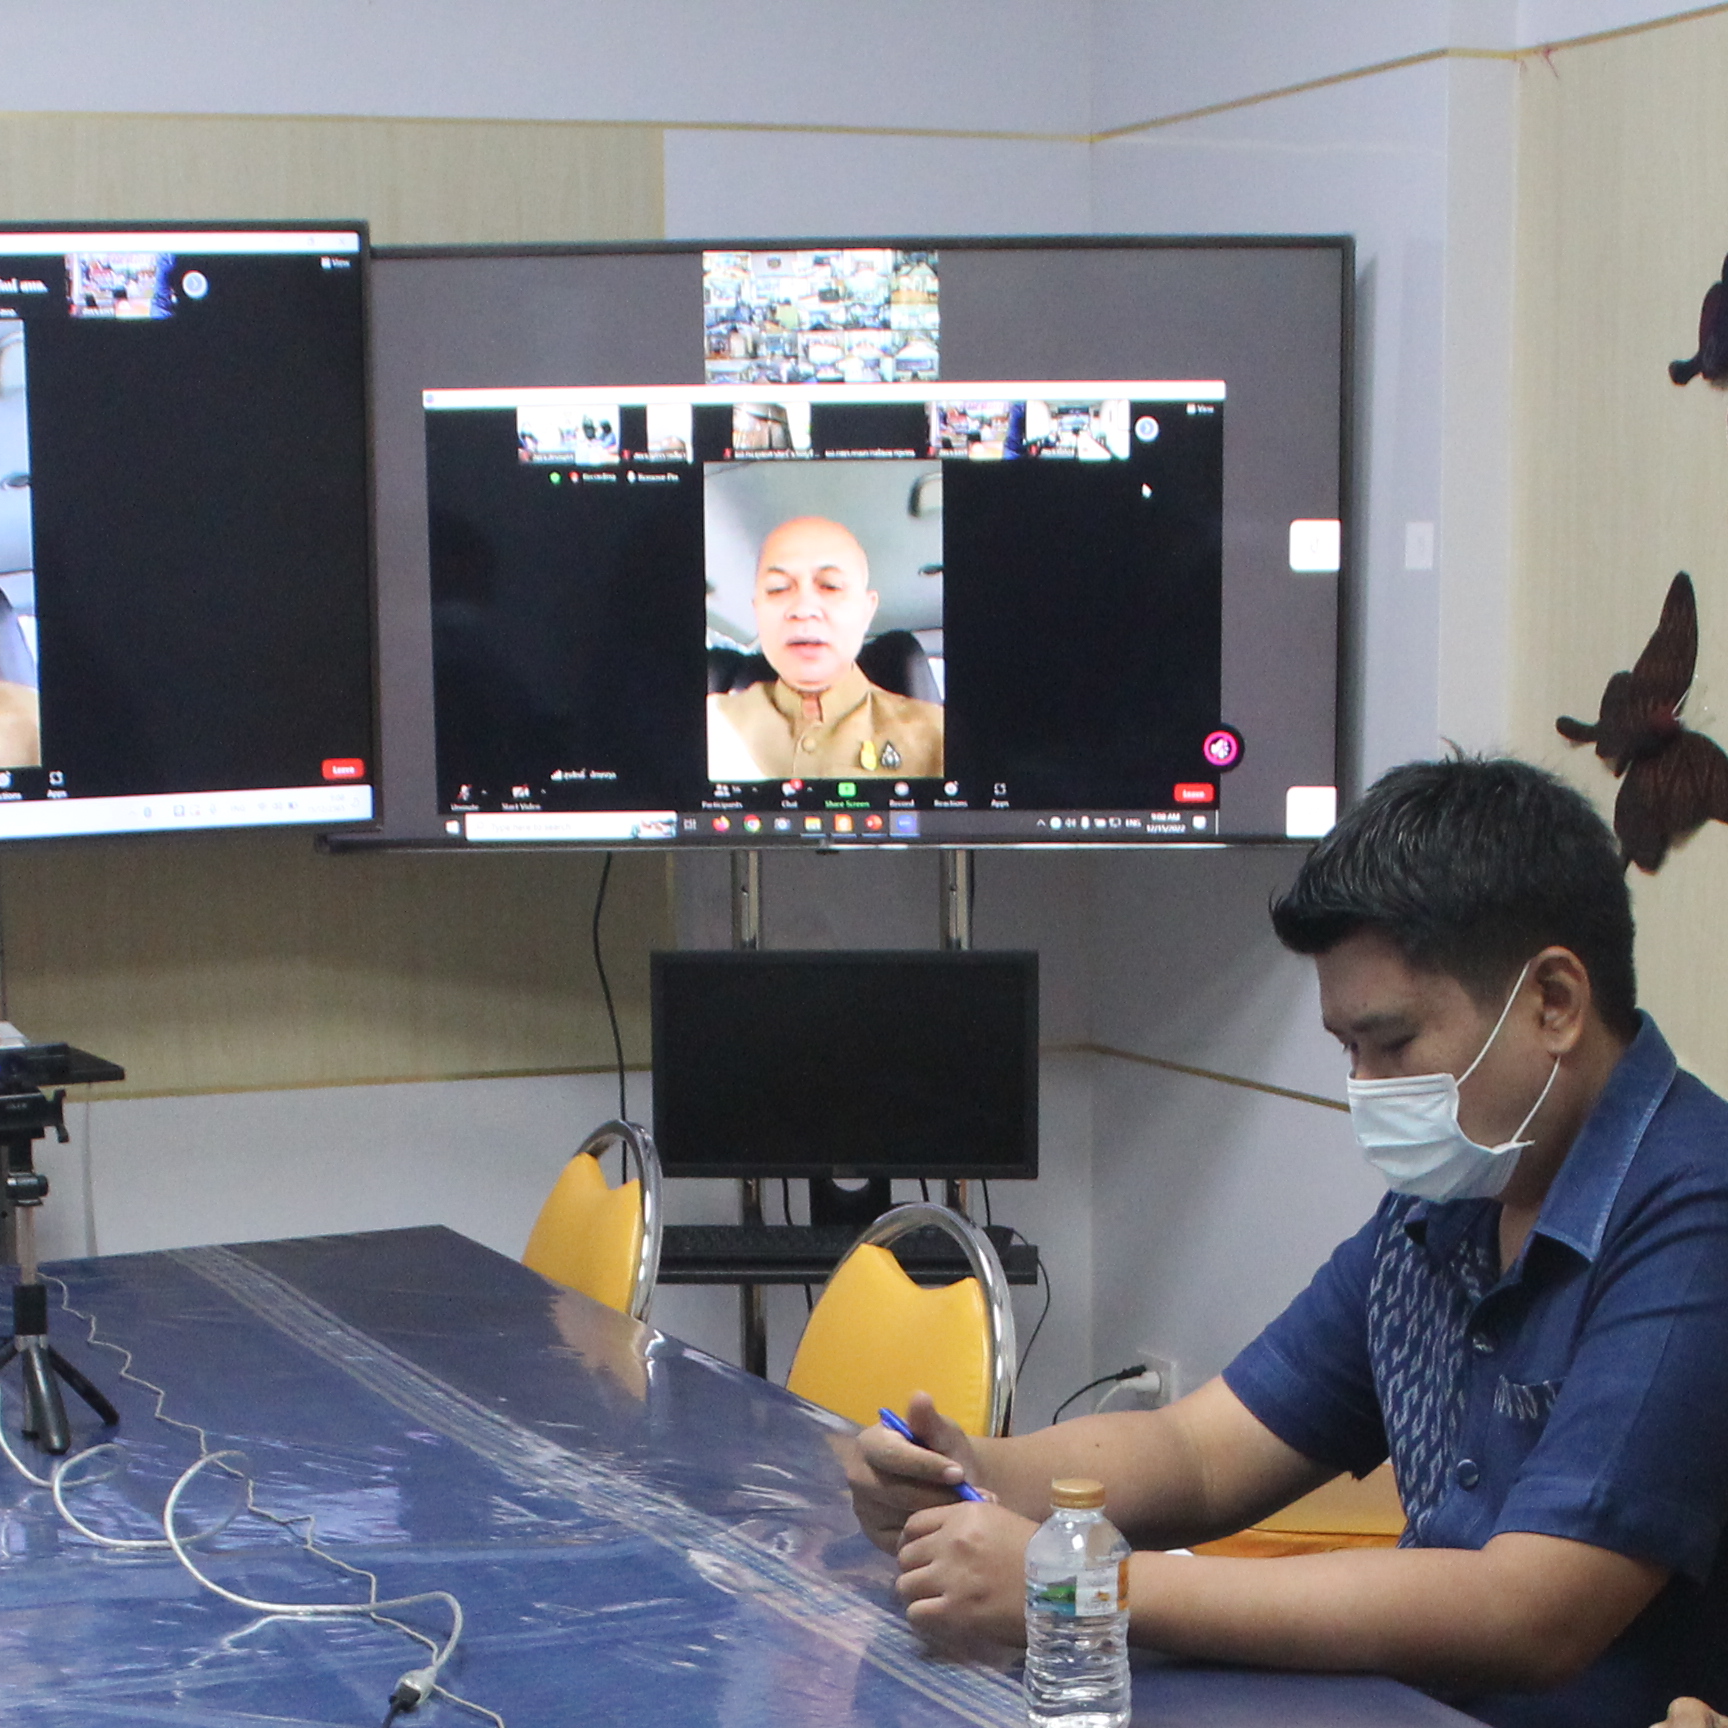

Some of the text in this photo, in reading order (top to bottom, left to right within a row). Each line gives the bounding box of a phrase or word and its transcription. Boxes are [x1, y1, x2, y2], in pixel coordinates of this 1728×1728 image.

[825, 799, 871, 809] Share Screen
[888, 799, 915, 808] Record
[933, 799, 969, 808] Reactions
[1125, 817, 1142, 828] ENG
